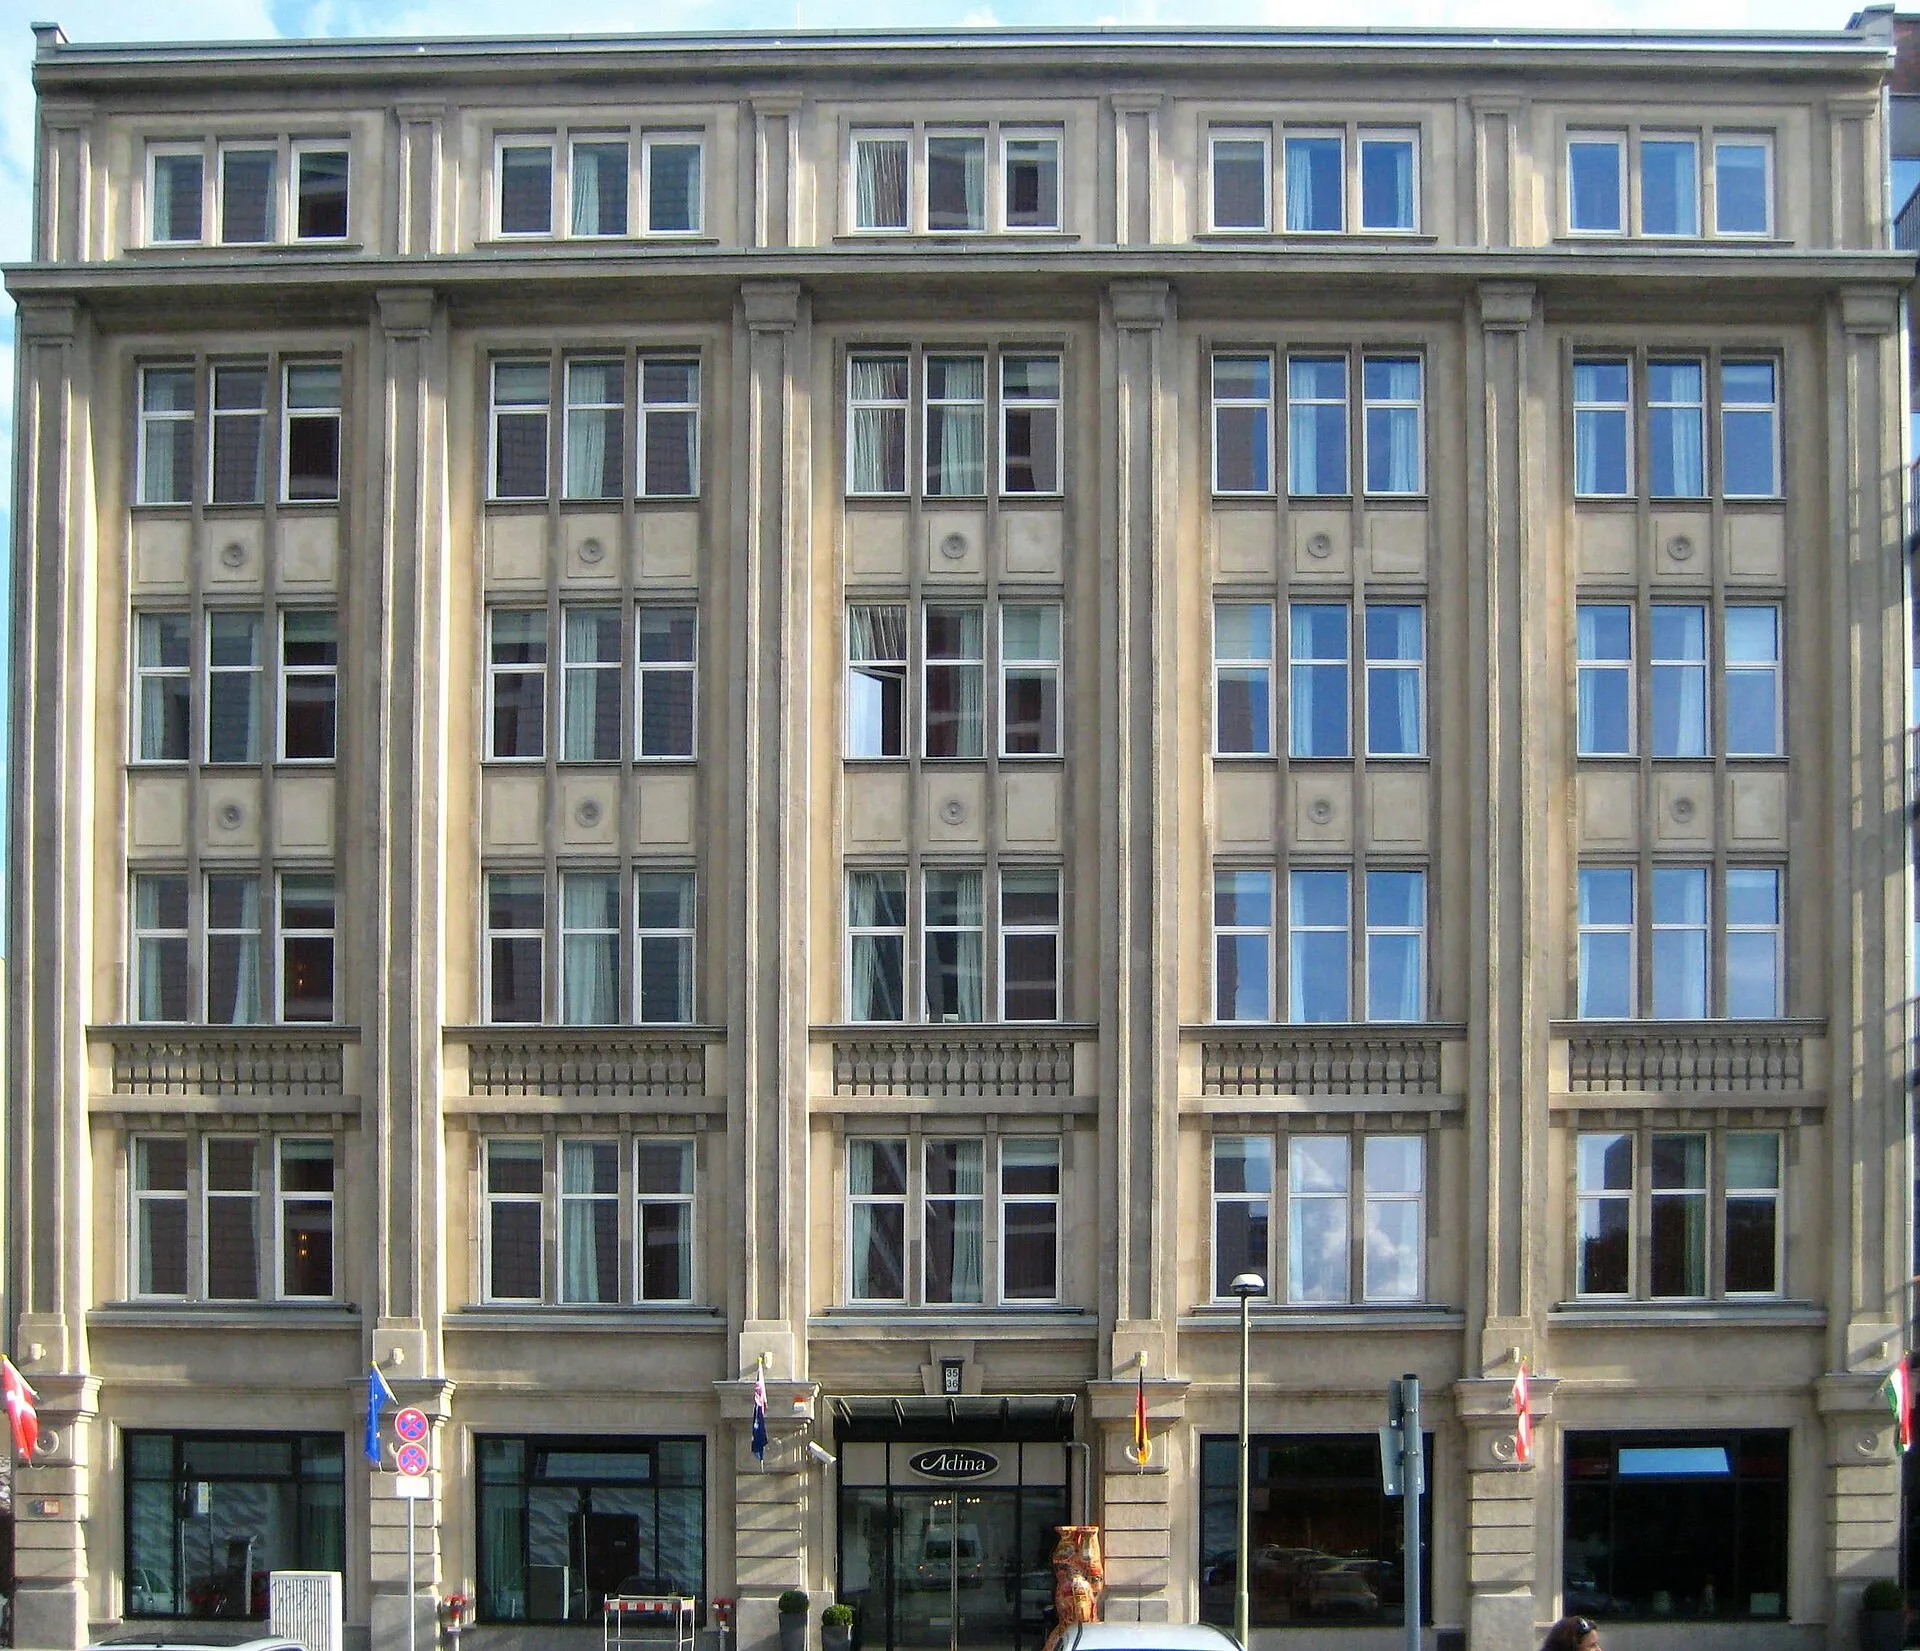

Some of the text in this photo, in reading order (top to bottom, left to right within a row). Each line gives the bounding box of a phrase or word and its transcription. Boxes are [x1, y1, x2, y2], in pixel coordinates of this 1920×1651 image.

[946, 1369, 958, 1377] 35
[946, 1380, 958, 1388] 36
[920, 1453, 986, 1471] Adina
